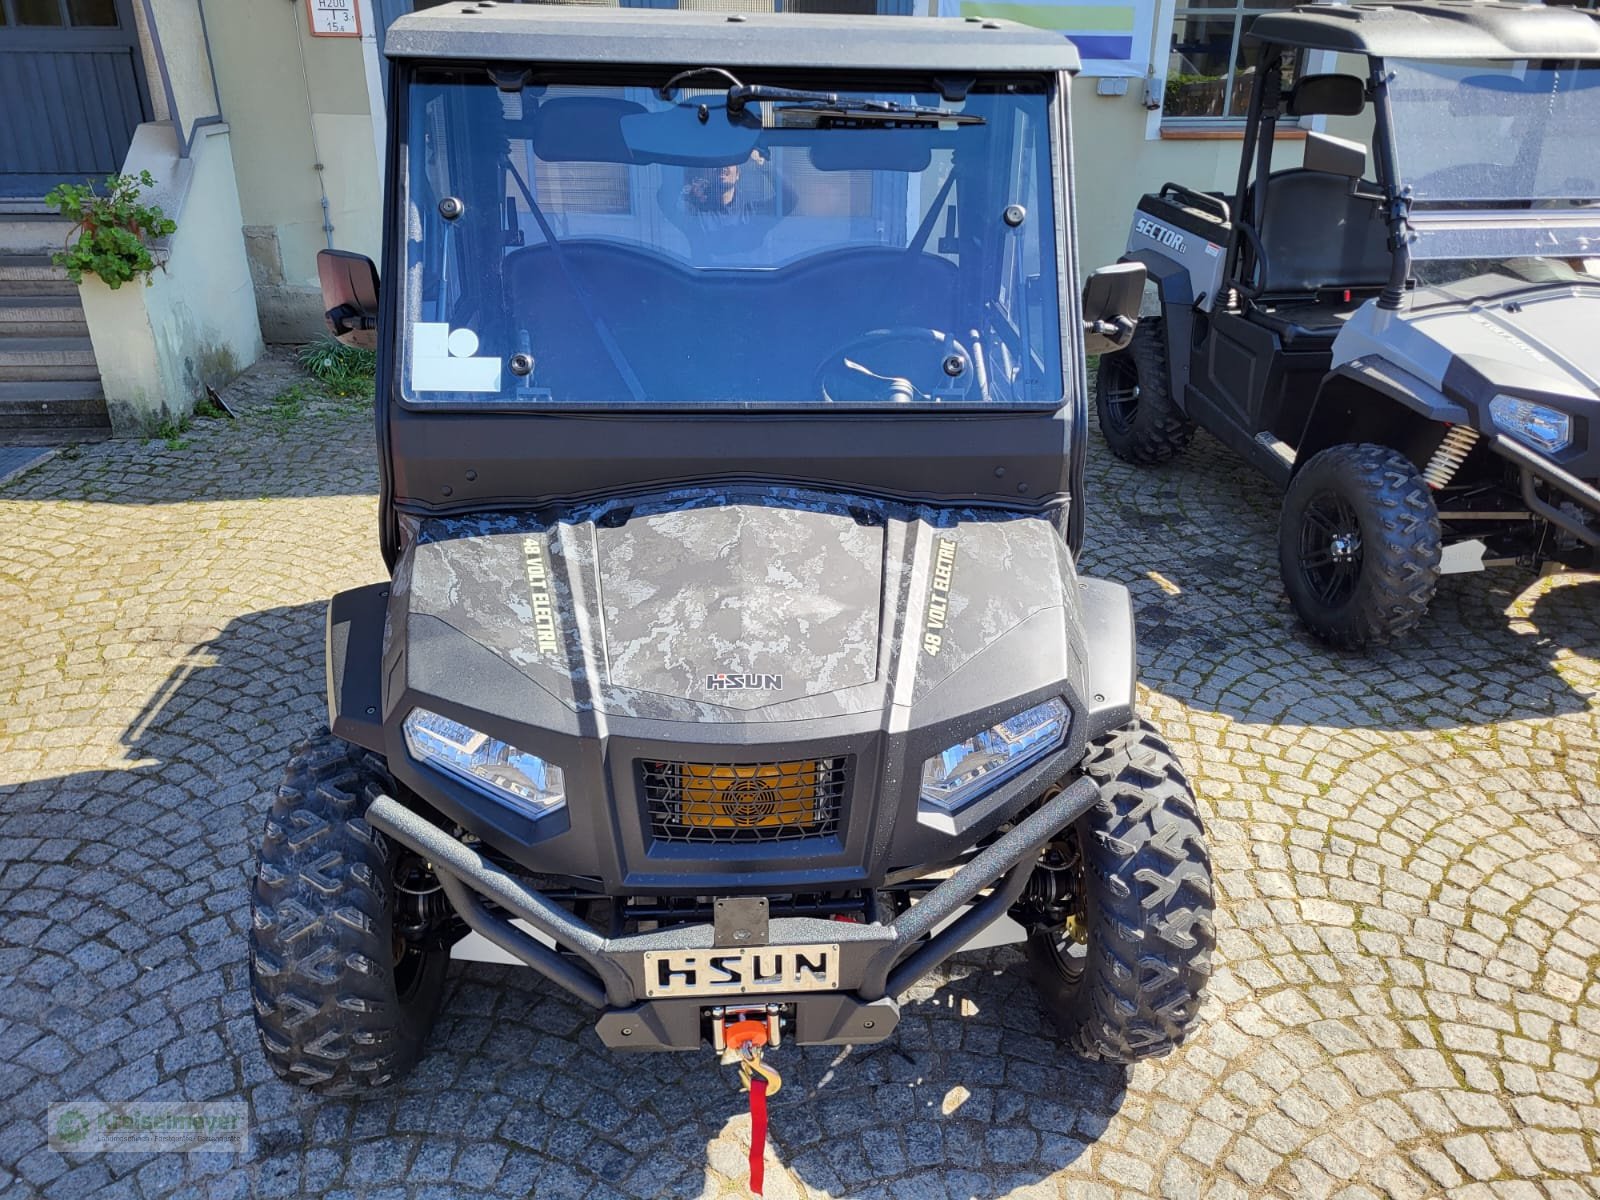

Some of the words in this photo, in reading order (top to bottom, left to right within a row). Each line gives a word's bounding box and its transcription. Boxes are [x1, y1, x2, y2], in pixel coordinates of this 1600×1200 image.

[1135, 218, 1184, 251] SECTOR
[523, 537, 540, 554] 48
[526, 557, 547, 588] VOLT
[933, 539, 956, 592] ELECTRIC
[532, 593, 558, 654] ELECTRIC
[927, 593, 948, 629] VOLT
[923, 632, 942, 657] 48
